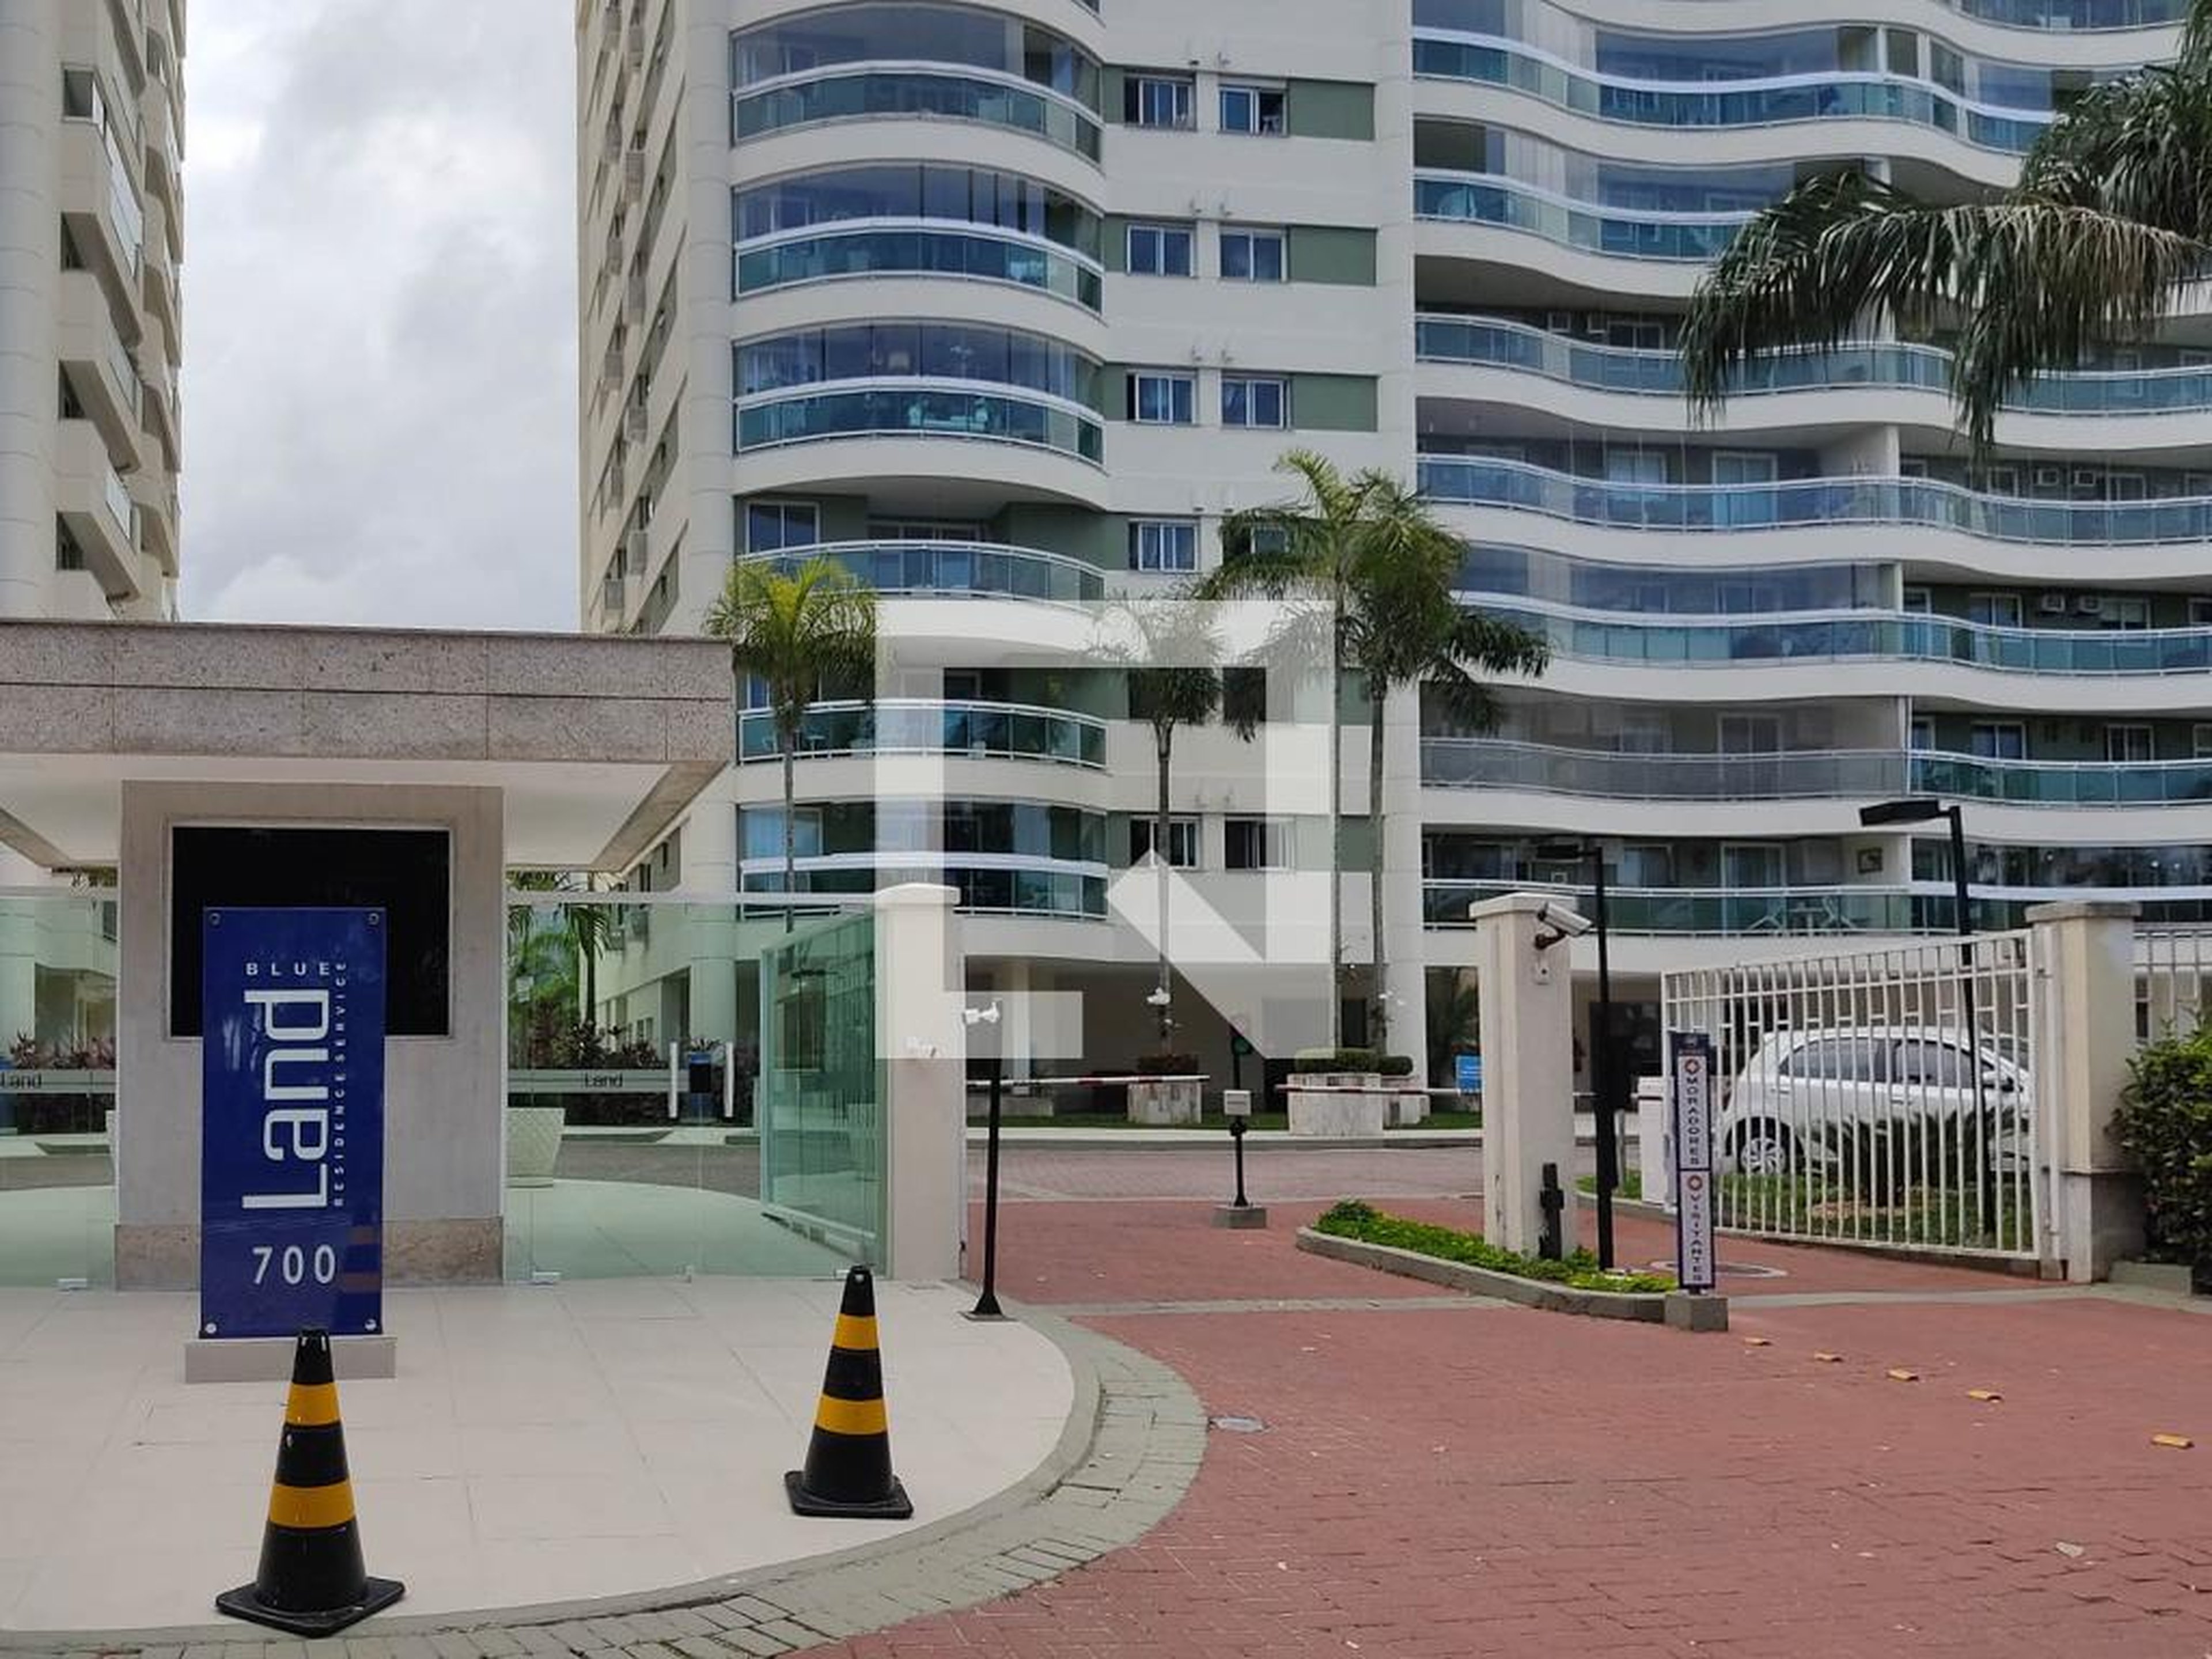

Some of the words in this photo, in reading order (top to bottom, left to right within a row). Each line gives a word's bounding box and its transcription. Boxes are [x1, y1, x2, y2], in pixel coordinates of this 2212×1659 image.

[246, 962, 330, 976] BLUE
[335, 963, 346, 1063] SERVICE
[1, 1072, 42, 1089] Land
[242, 989, 329, 1209] Land
[584, 1073, 623, 1088] Land
[334, 1074, 346, 1207] RESIDENCE
[252, 1245, 336, 1285] 700
